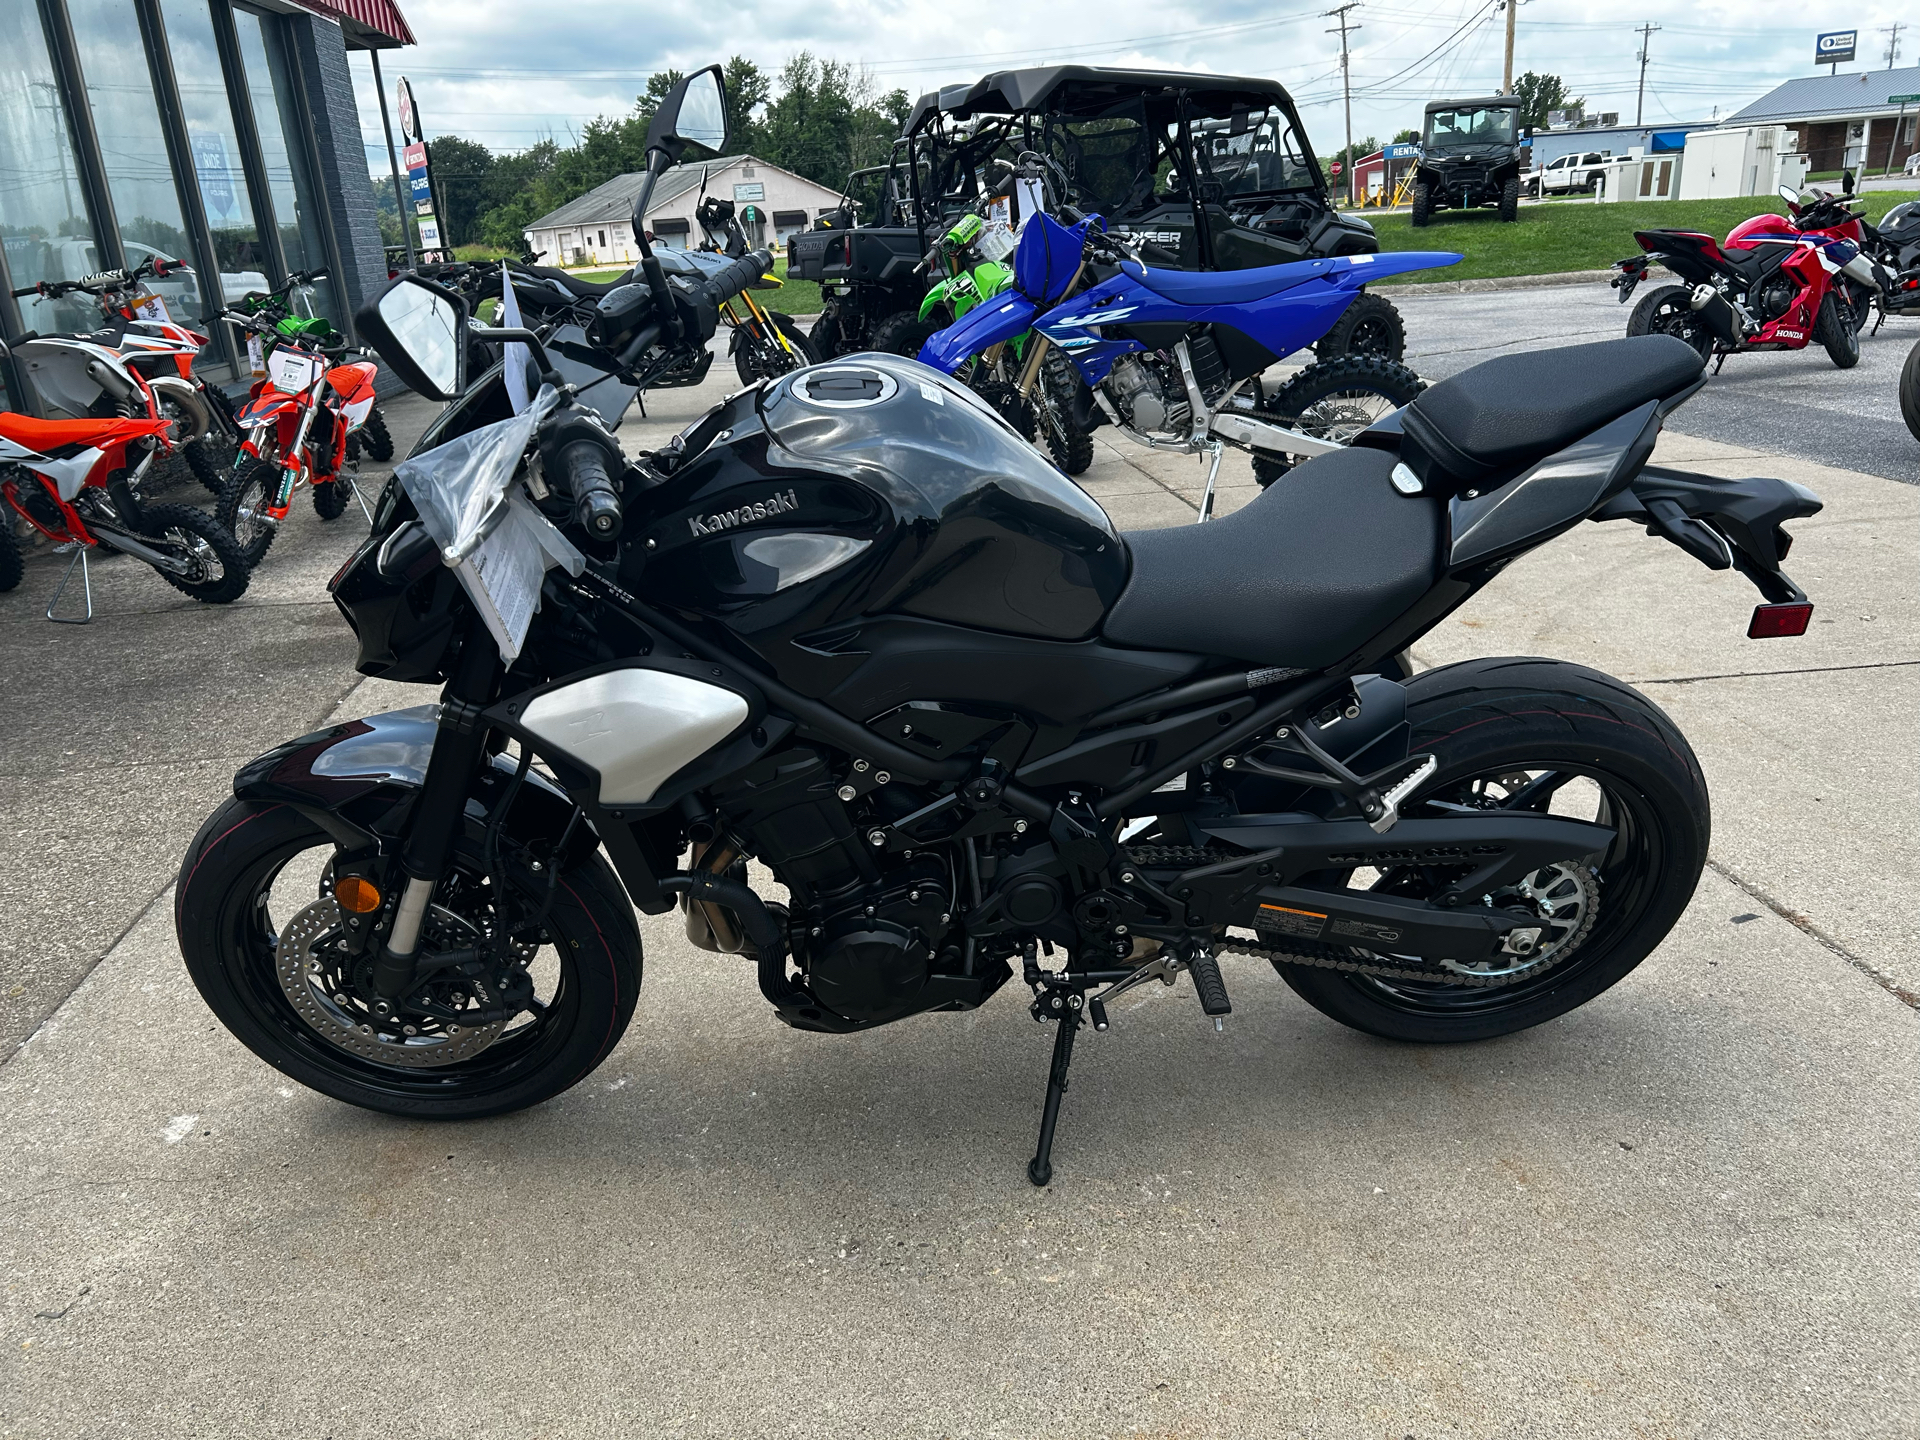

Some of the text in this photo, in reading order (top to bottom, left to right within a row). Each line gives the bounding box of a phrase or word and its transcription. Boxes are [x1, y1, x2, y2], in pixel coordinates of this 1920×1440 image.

[1393, 146, 1420, 156] RENTA
[797, 241, 824, 251] HONDA
[691, 253, 722, 264] SUZUKI
[1049, 306, 1139, 328] YZ
[1775, 330, 1803, 340] HONDA
[277, 470, 288, 500] DUNLOP
[687, 488, 799, 537] Kawasaki
